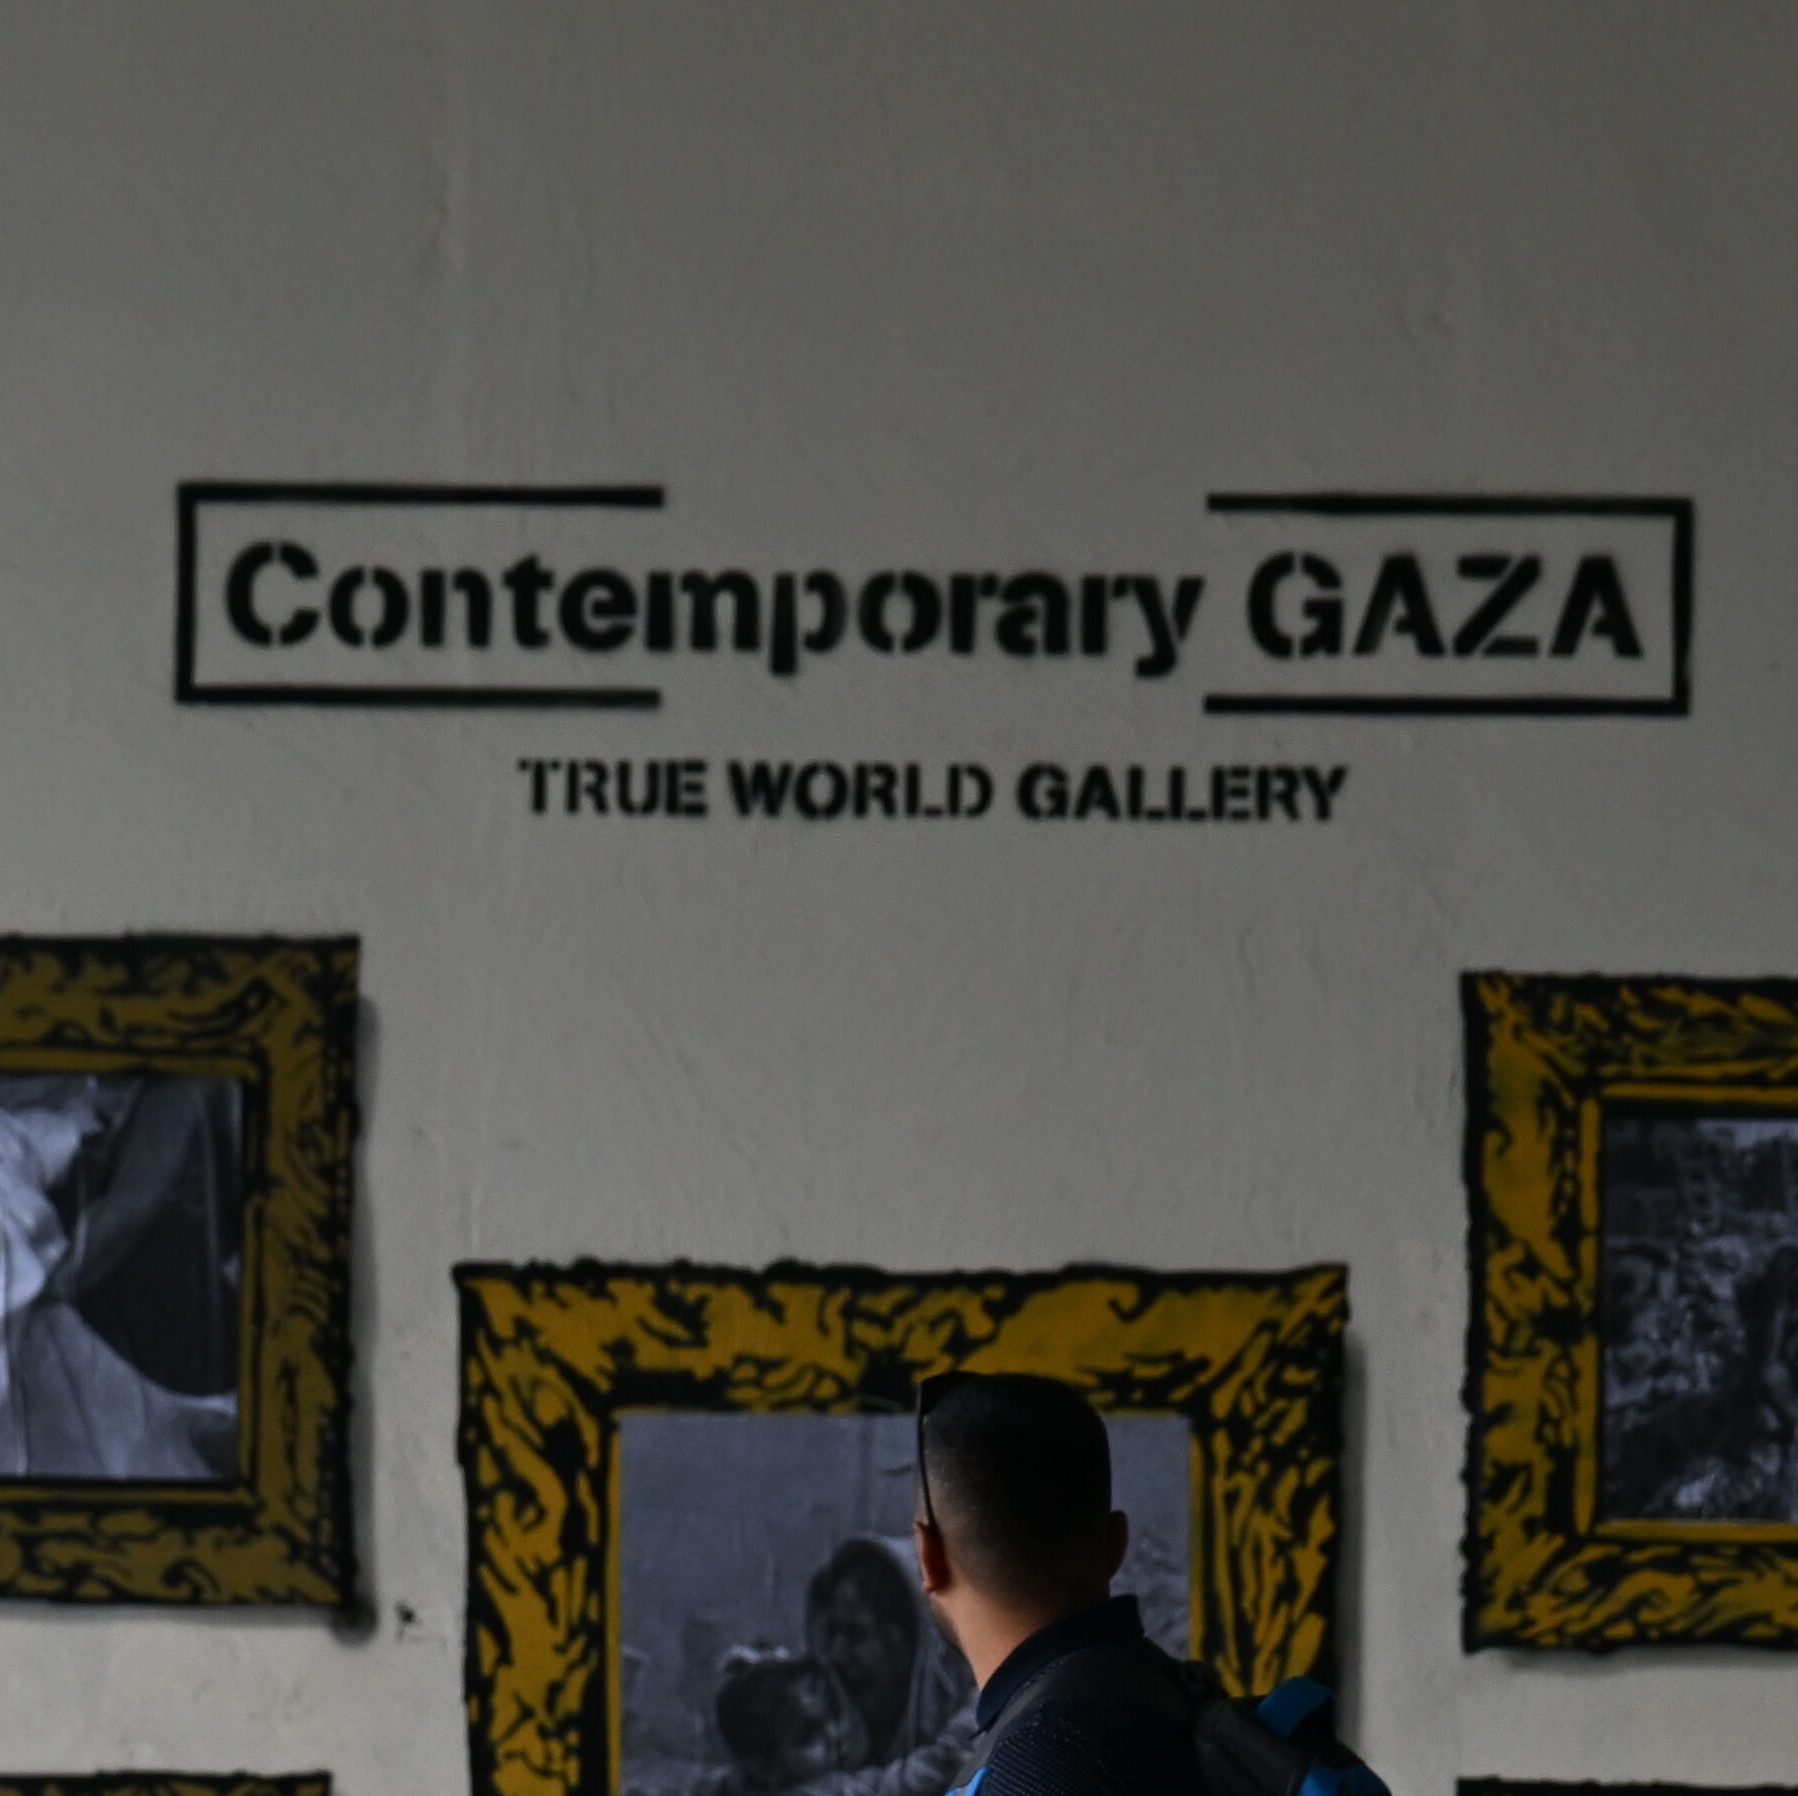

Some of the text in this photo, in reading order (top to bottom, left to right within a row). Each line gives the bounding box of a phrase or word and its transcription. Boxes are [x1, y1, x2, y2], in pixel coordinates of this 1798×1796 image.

[223, 540, 1646, 680] Contemporary GAZA
[518, 758, 1348, 823] TRUE WORLD GALLERY
